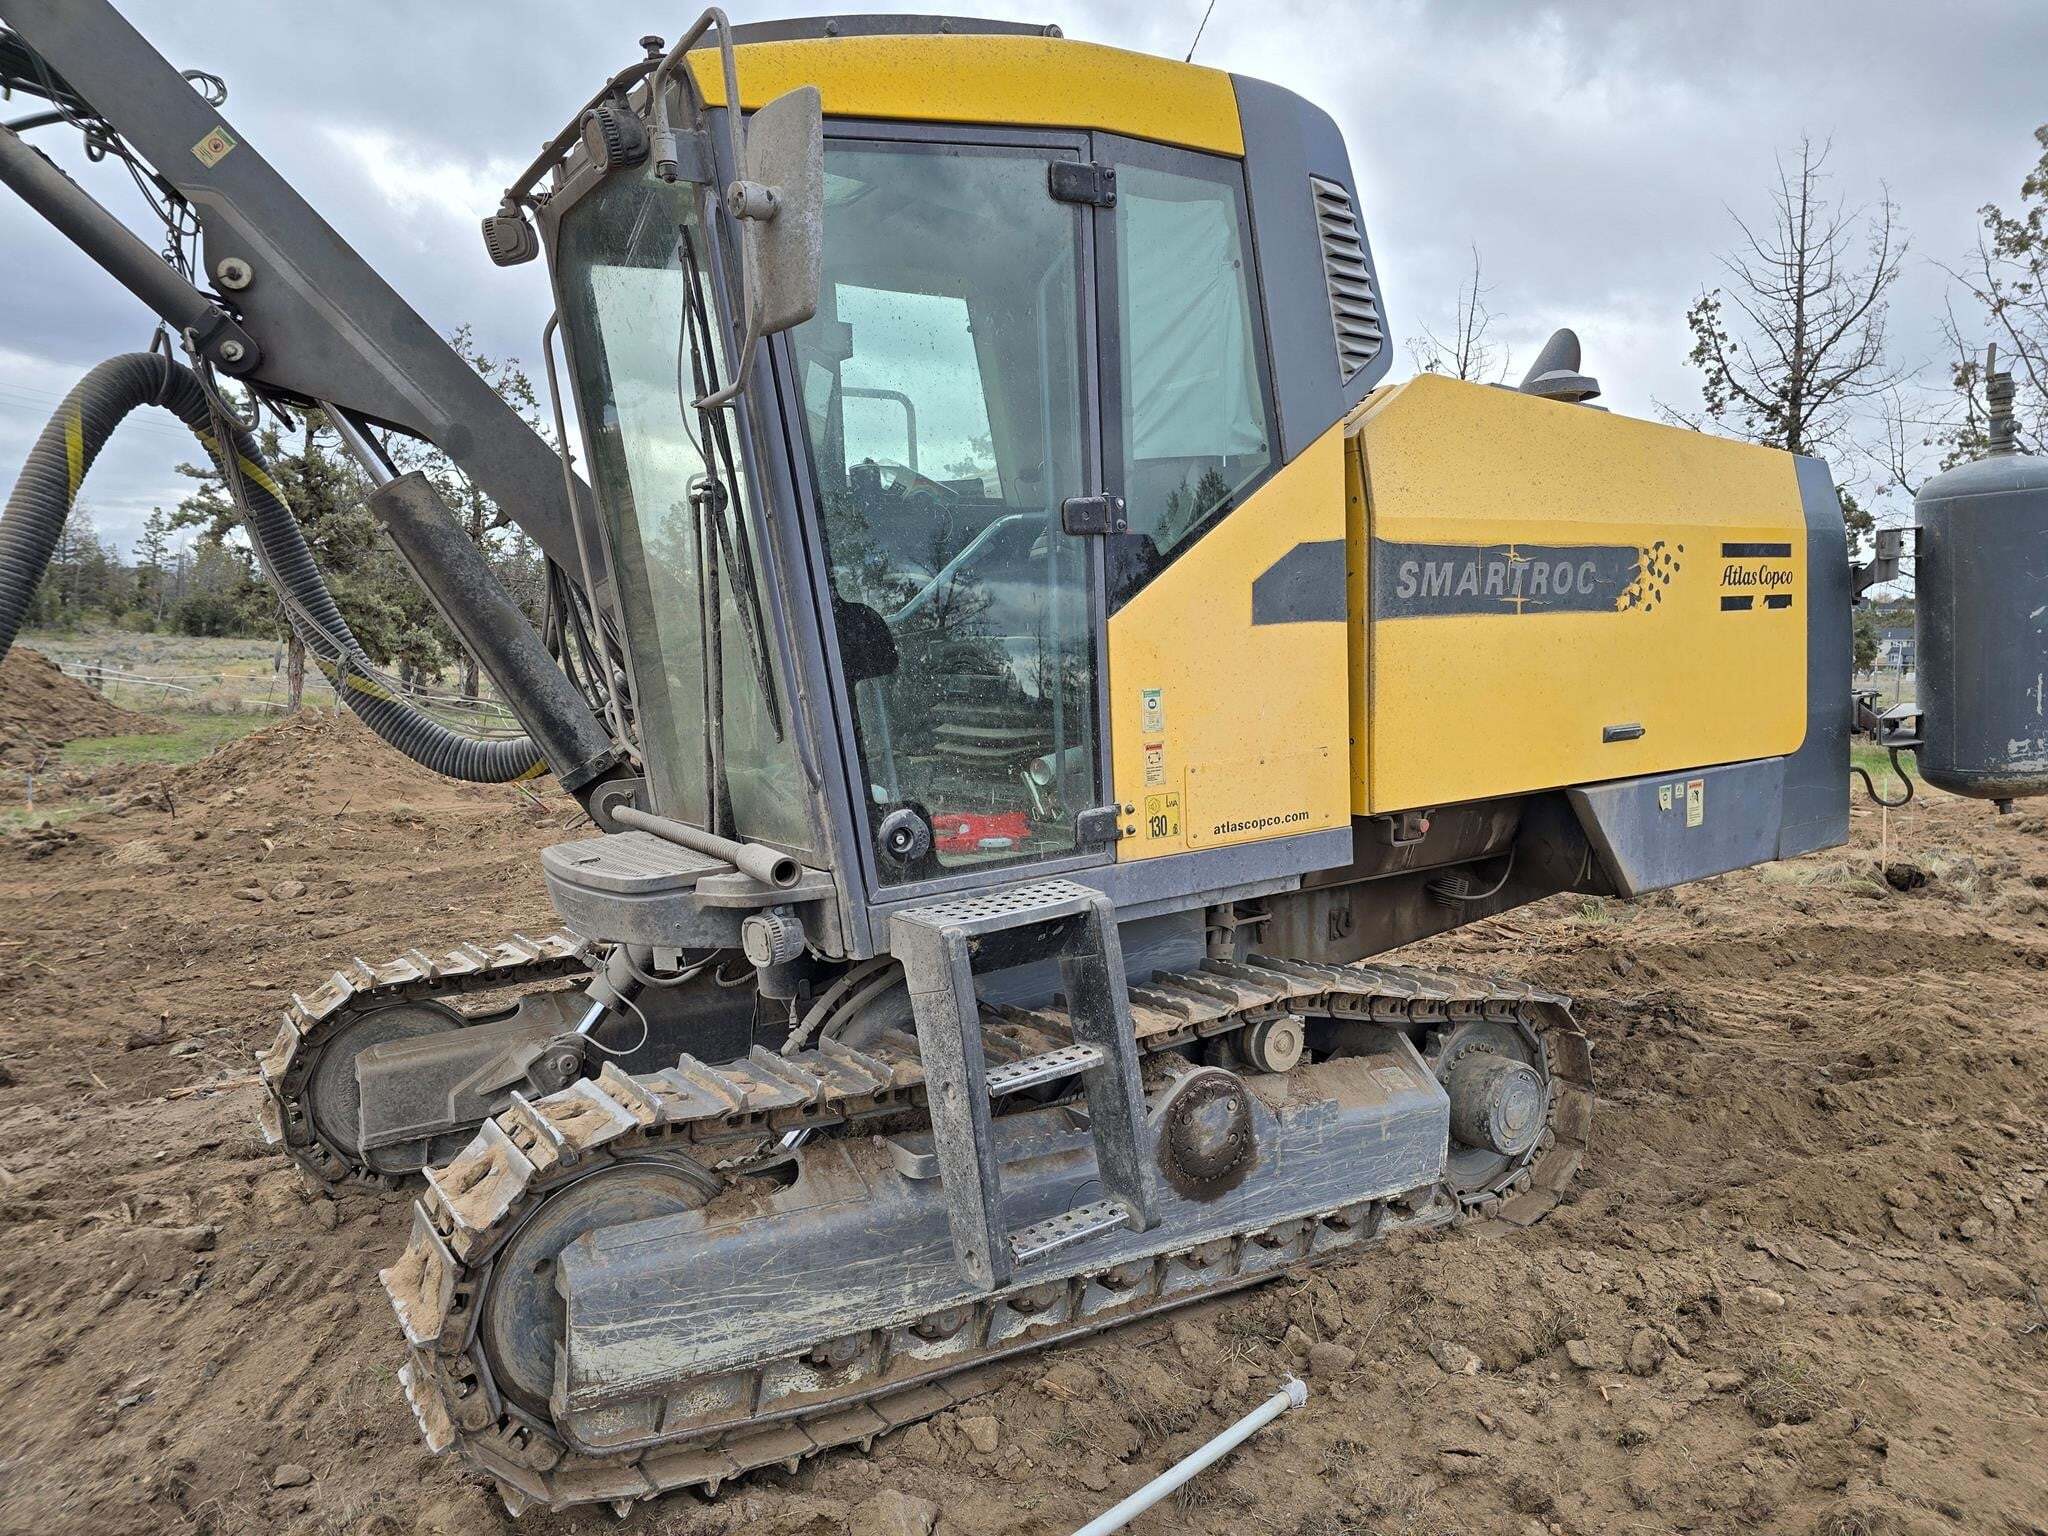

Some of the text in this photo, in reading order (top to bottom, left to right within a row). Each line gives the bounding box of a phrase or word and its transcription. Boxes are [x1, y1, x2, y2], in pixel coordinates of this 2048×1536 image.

[1396, 560, 1597, 599] SMARTROC
[1720, 564, 1793, 589] Atlas Copco
[1149, 814, 1168, 838] 130
[1213, 809, 1310, 836] atlascopco.com
